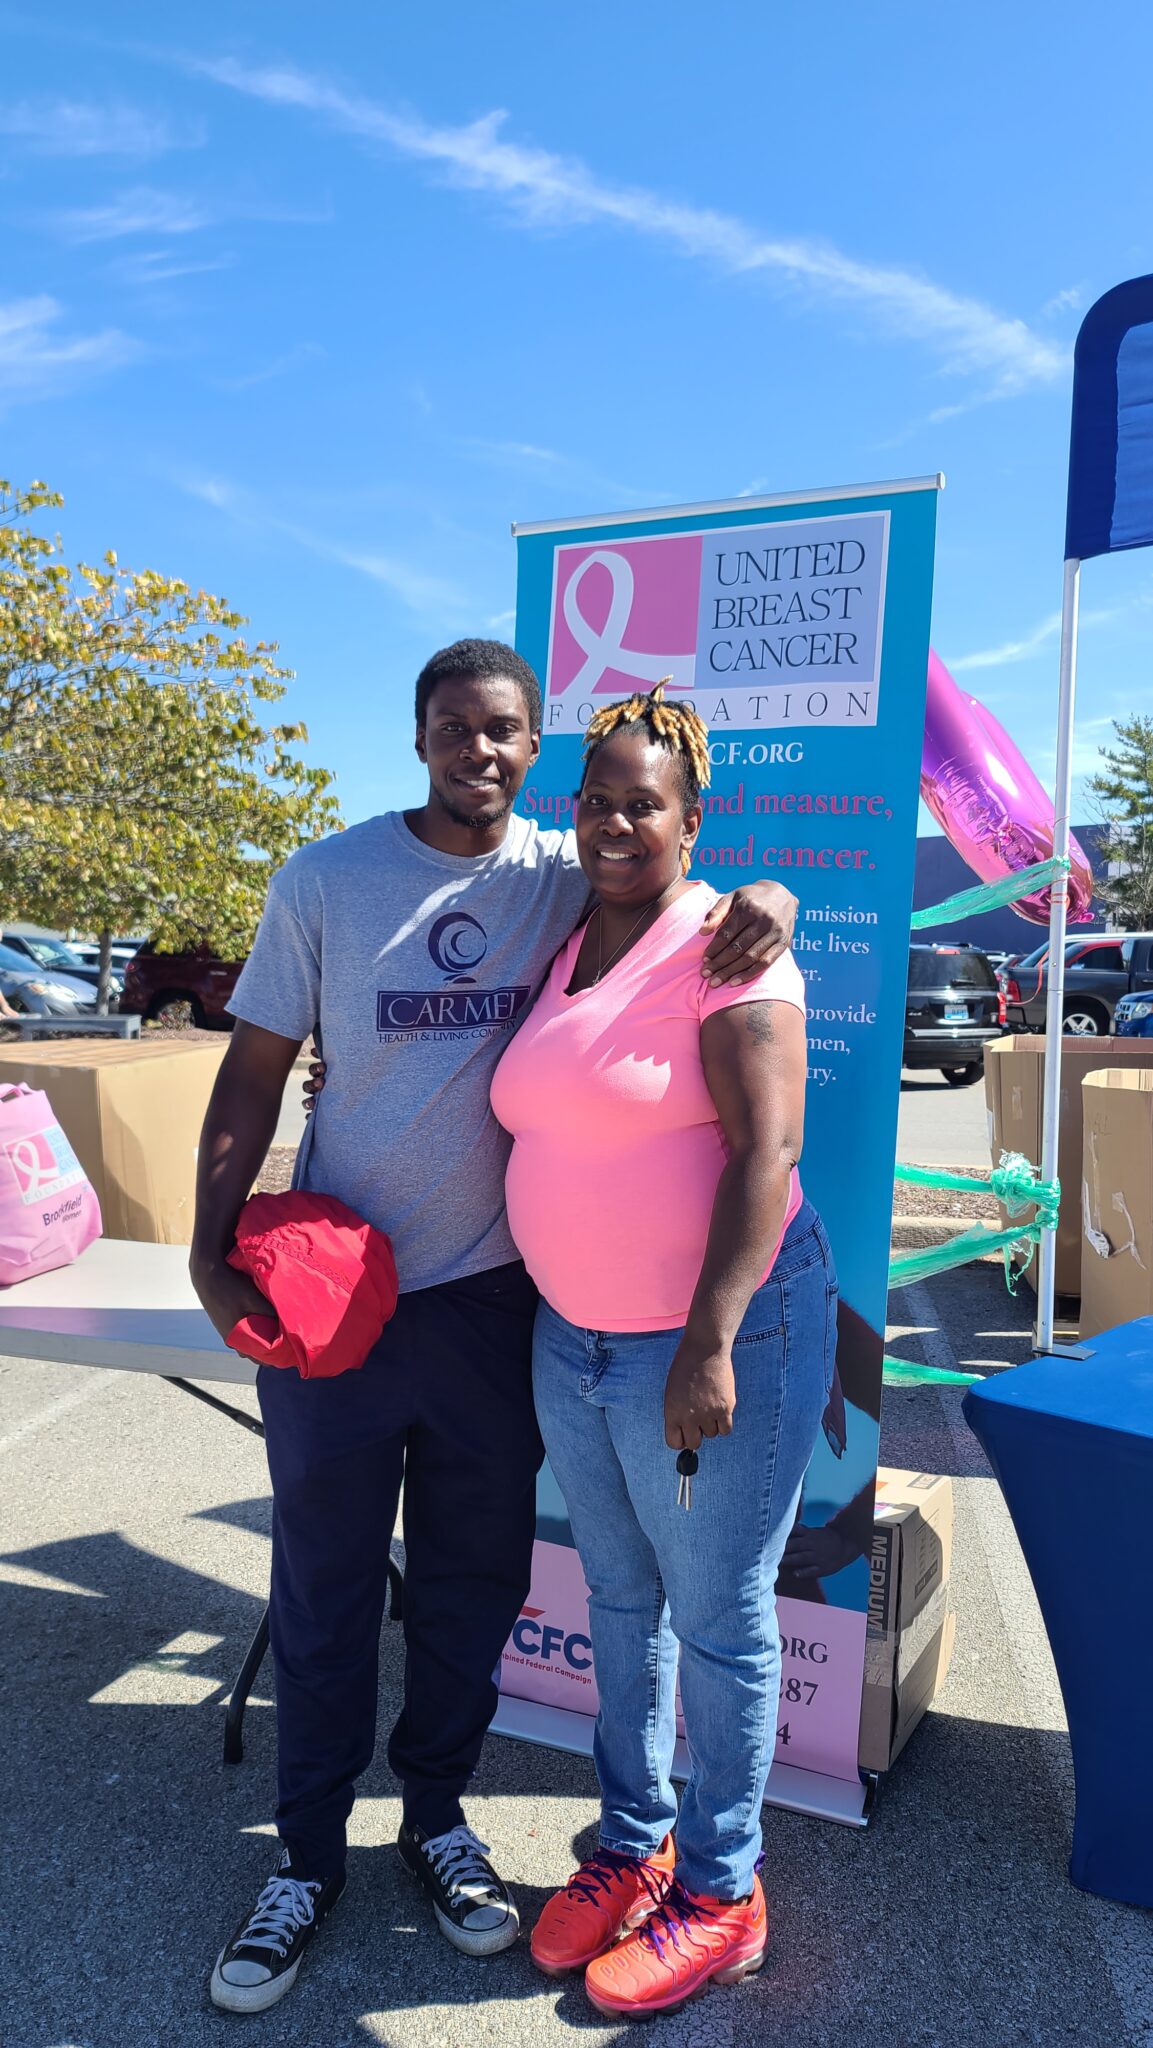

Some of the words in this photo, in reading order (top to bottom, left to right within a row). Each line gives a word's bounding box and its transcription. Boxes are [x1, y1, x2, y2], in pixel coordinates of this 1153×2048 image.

[715, 540, 866, 586] UNITED
[711, 587, 863, 630] BREAST
[709, 632, 859, 673] CANCER
[548, 691, 871, 727] FOATION
[754, 793, 893, 821] measure,
[763, 847, 876, 870] cancer.
[805, 905, 878, 925] mission
[792, 931, 822, 952] the
[828, 932, 870, 954] lives
[379, 1032, 418, 1043] HEALTH
[420, 1031, 430, 1041] &
[434, 1030, 469, 1041] LIVING
[867, 1535, 888, 1632] MEDIUM
[512, 1619, 593, 1670] CFC
[525, 1659, 554, 1673] Federal
[555, 1667, 592, 1685] Campaign
